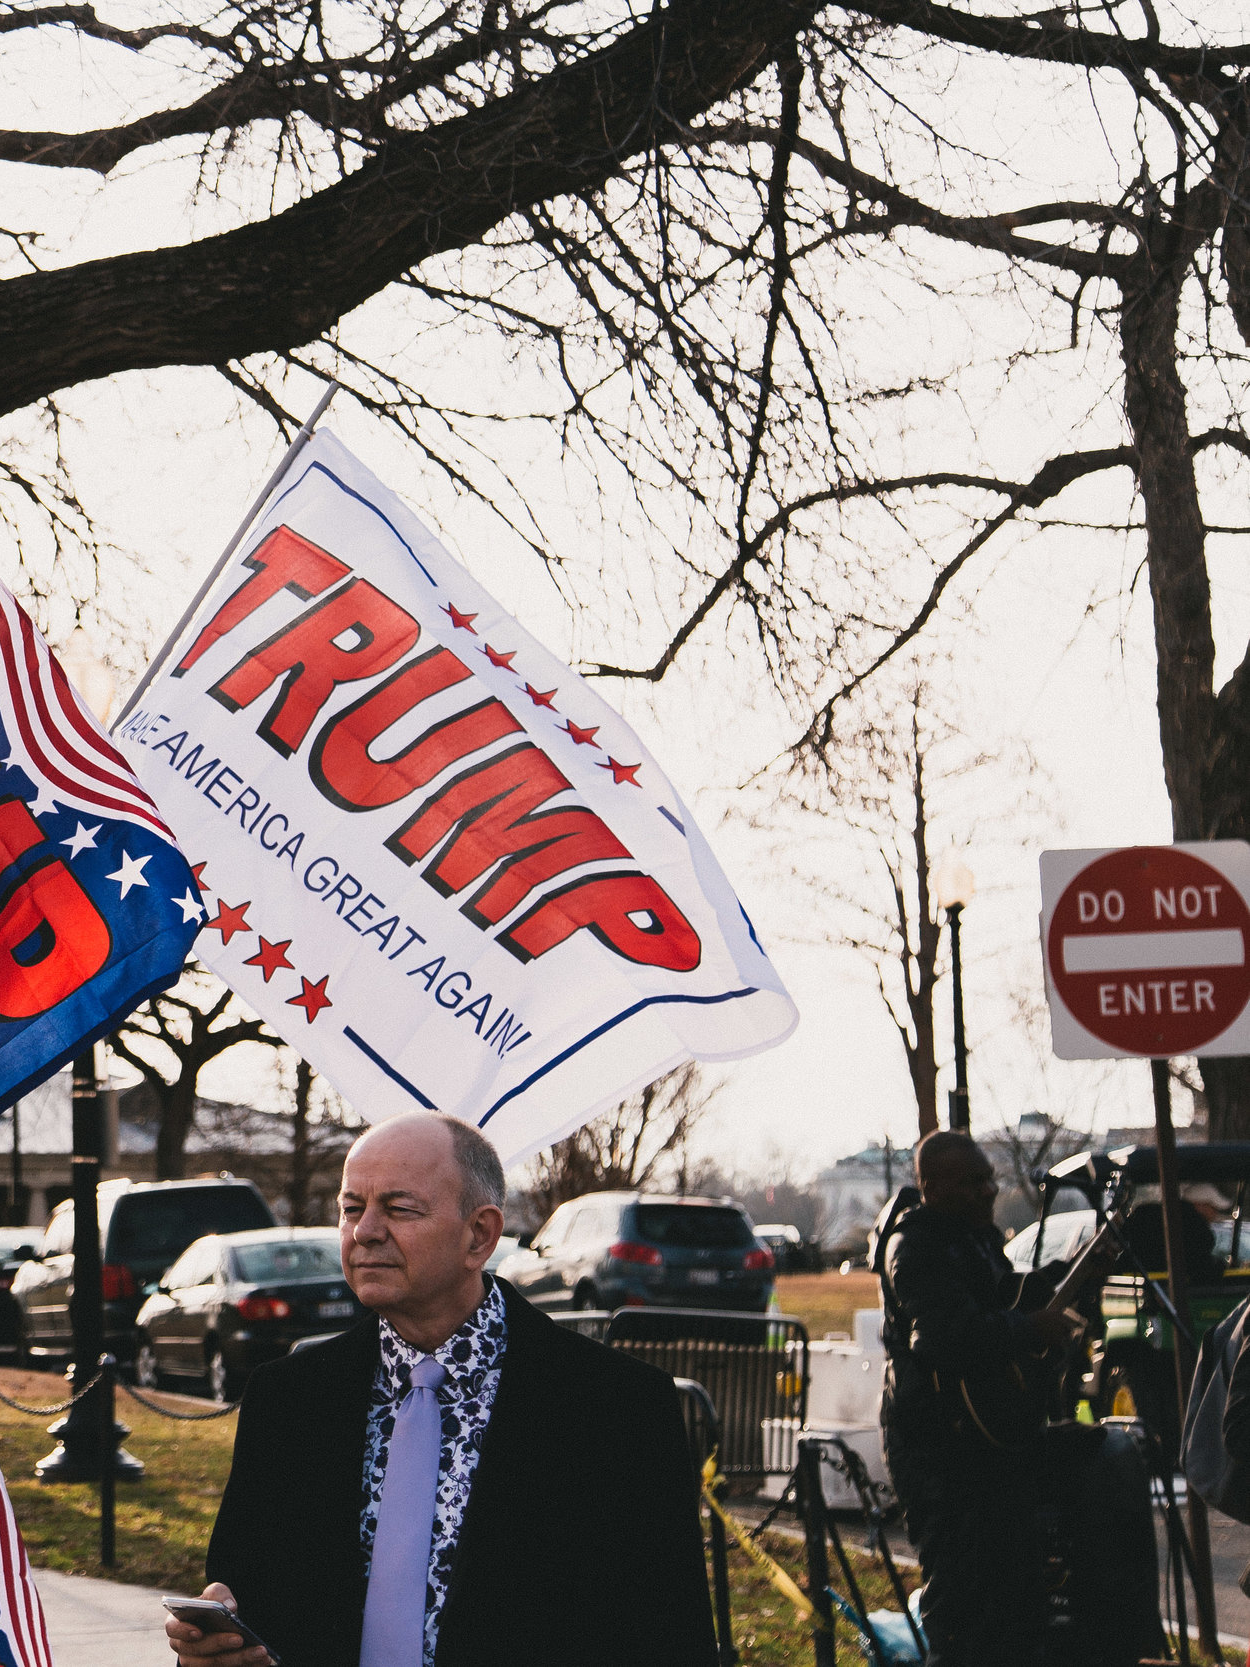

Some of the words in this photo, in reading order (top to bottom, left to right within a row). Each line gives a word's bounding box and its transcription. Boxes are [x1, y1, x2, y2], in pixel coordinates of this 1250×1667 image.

[170, 524, 702, 972] TRUMP
[151, 730, 305, 872] AMERICA
[303, 856, 427, 960] GREAT
[406, 955, 532, 1060] AGAIN!
[1078, 890, 1126, 923] DO
[1153, 885, 1222, 920] NOT
[1099, 980, 1216, 1017] ENTER
